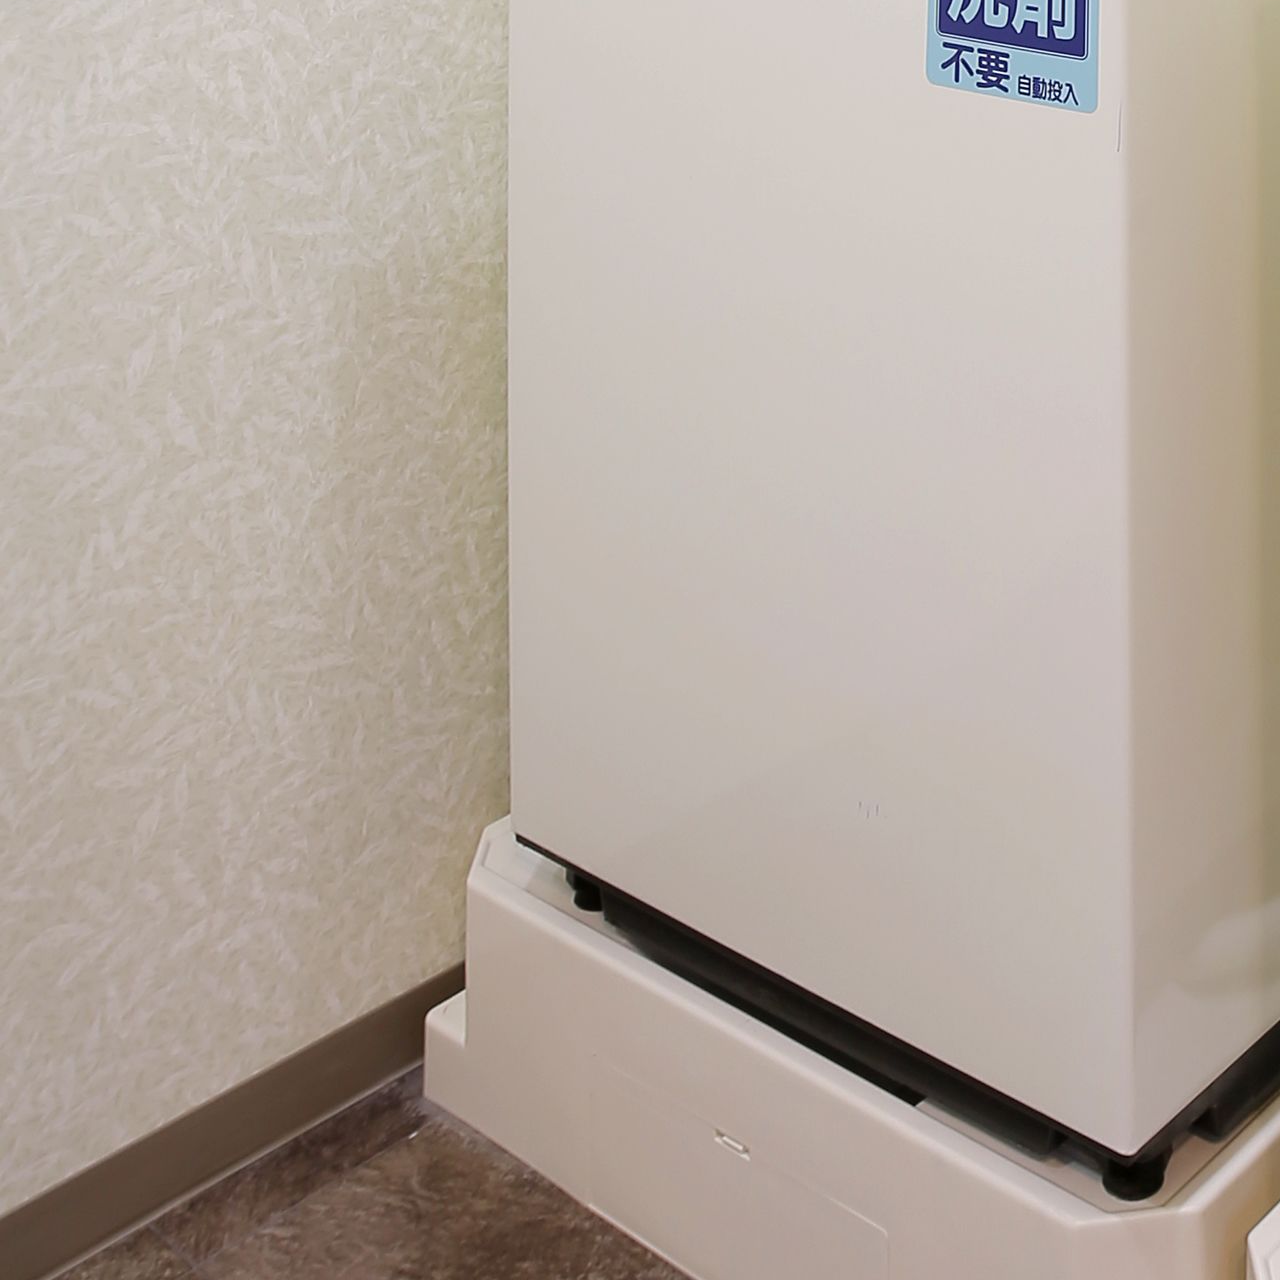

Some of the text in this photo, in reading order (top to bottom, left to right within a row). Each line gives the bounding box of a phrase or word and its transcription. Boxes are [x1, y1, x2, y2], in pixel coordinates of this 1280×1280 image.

[940, 41, 1080, 107] 不要 自動投入
